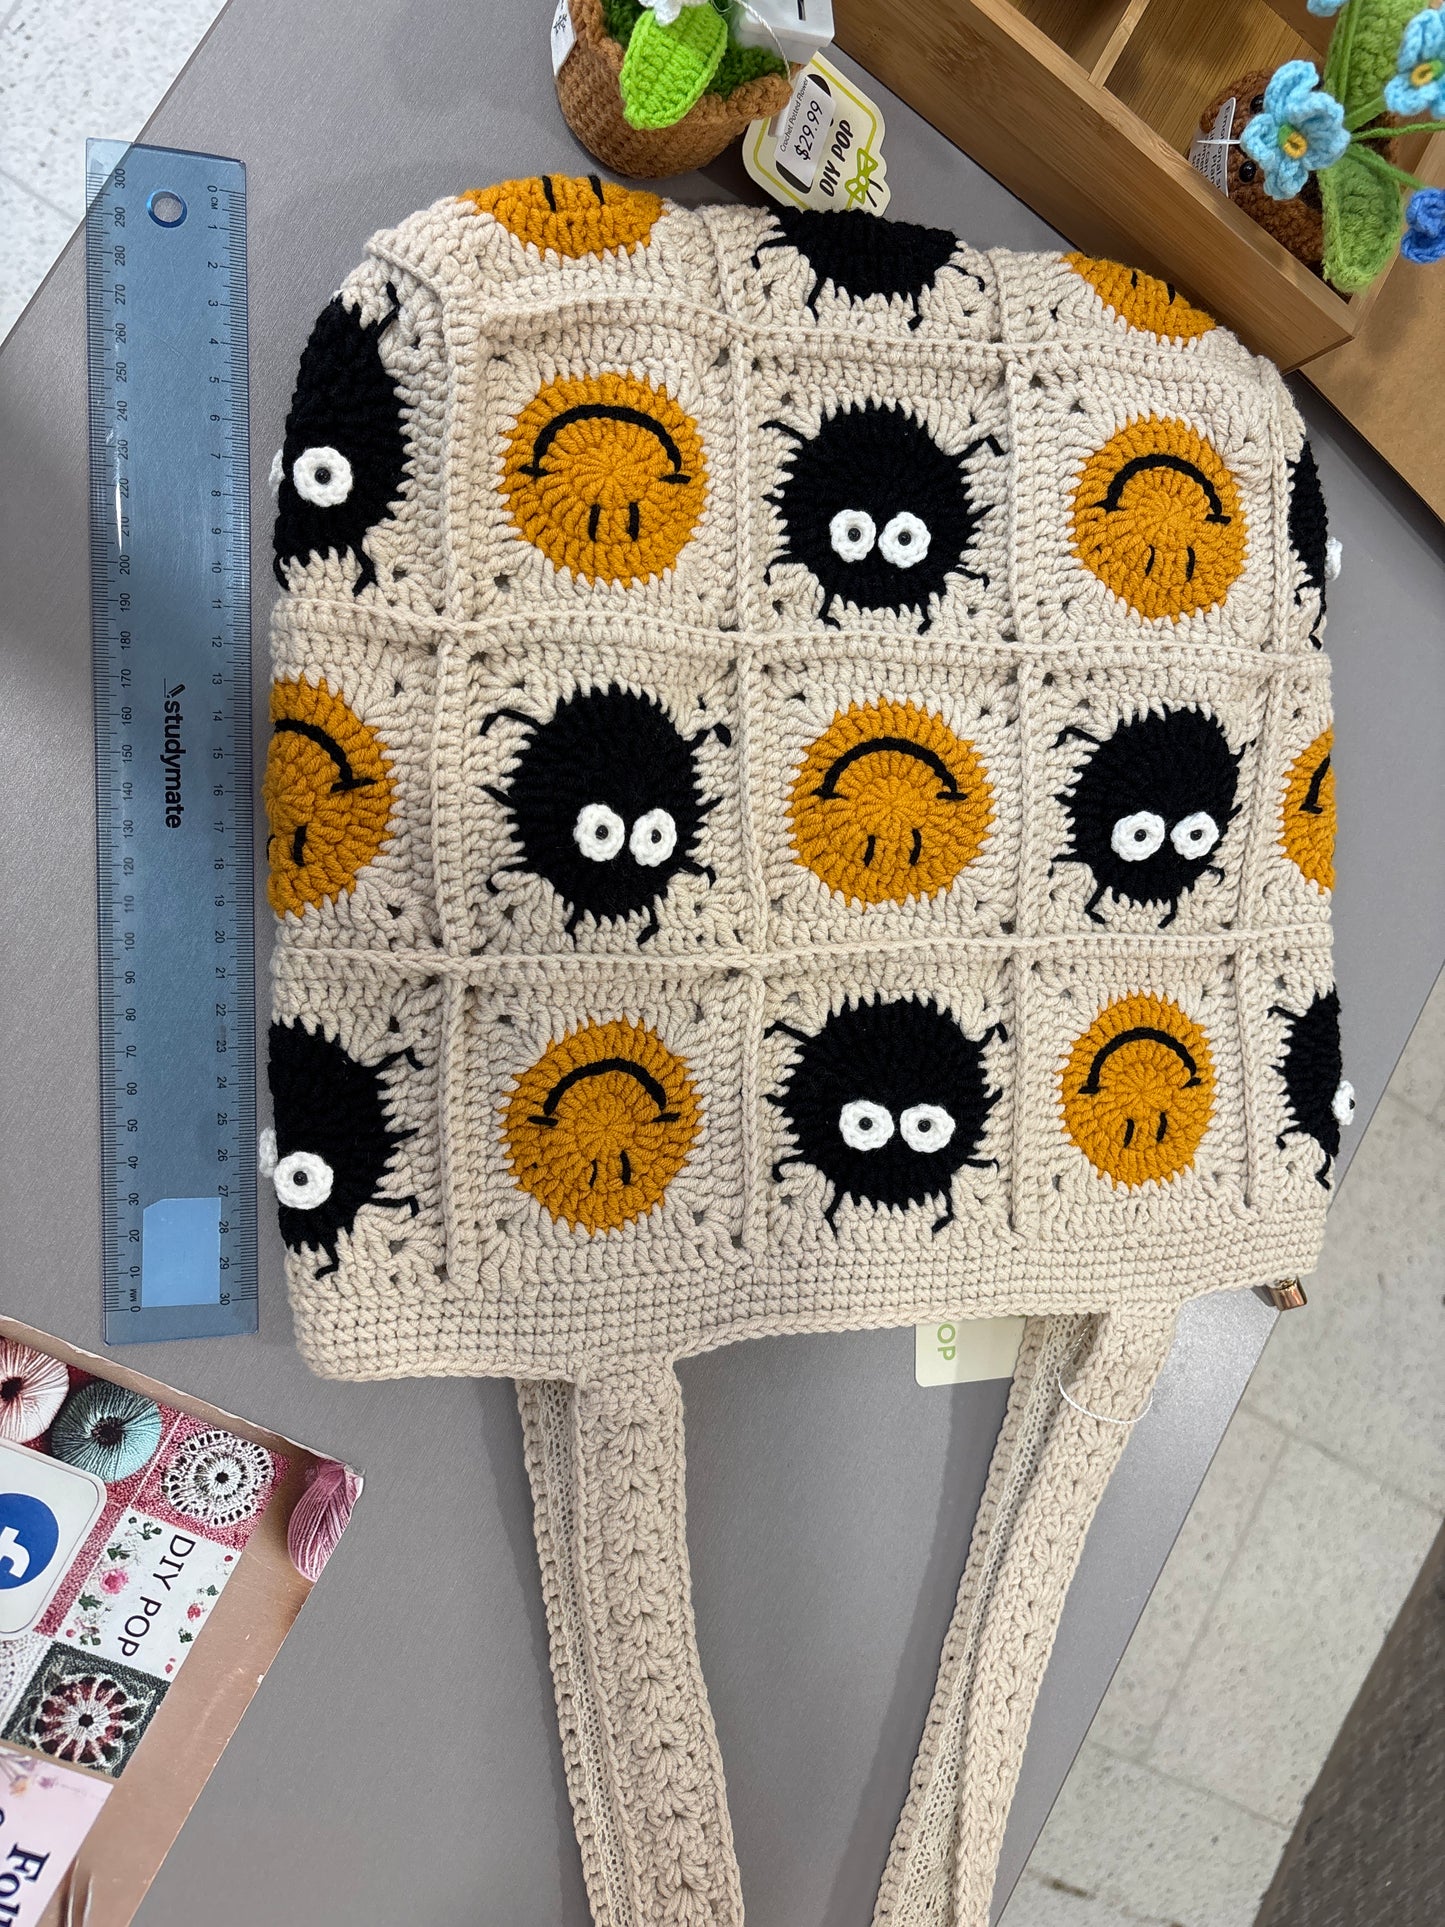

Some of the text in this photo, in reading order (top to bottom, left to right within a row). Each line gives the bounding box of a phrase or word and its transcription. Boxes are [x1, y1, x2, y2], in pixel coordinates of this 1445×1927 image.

[780, 77, 809, 152] Crochet Potted Flower
[794, 100, 822, 160] $29.99
[1216, 105, 1231, 175] Emoonal
[819, 120, 853, 197] DIY POP
[115, 168, 126, 188] 300
[210, 197, 218, 209] CM
[114, 207, 126, 227] 290
[115, 246, 126, 266] 280
[115, 284, 126, 304] 270
[116, 323, 126, 344] 260
[116, 362, 127, 383] 250
[117, 401, 128, 421] 240
[118, 439, 128, 460] 230
[118, 478, 129, 498] 220
[119, 516, 129, 537] 210
[120, 555, 130, 575] 200
[212, 561, 222, 573] 10
[120, 593, 130, 612] 190
[212, 600, 222, 609] 11
[121, 631, 131, 650] 180
[212, 635, 222, 648] 12
[121, 669, 131, 688] 170
[212, 673, 222, 685] 13
[122, 707, 132, 726] 160
[212, 710, 222, 722] 14
[122, 745, 132, 763] 150
[213, 748, 222, 759] 15
[160, 700, 187, 829] studymate
[123, 782, 133, 801] 140
[213, 784, 223, 796] 16
[123, 820, 133, 838] 130
[214, 821, 223, 833] 17
[124, 857, 134, 876] 120
[215, 858, 224, 870] 18
[124, 895, 134, 913] 110
[215, 895, 224, 907] 19
[125, 932, 135, 951] 100
[215, 931, 225, 943] 20
[126, 971, 135, 984] 90
[216, 968, 225, 979] 21
[126, 1008, 136, 1021] 80
[216, 1004, 226, 1016] 22
[127, 1045, 136, 1058] 70
[217, 1040, 226, 1053] 23
[127, 1082, 137, 1095] 60
[217, 1076, 227, 1089] 24
[128, 1119, 137, 1132] 50
[218, 1113, 227, 1125] 25
[218, 1149, 227, 1161] 26
[128, 1156, 138, 1169] 40
[218, 1185, 228, 1197] 27
[129, 1192, 139, 1205] 30
[219, 1221, 228, 1233] 28
[129, 1229, 139, 1242] 20
[220, 1257, 229, 1269] 29
[130, 1266, 140, 1278] 10
[130, 1289, 137, 1301] MM
[220, 1293, 230, 1305] 30
[937, 1323, 956, 1361] OP
[117, 1534, 197, 1657] DIY POP
